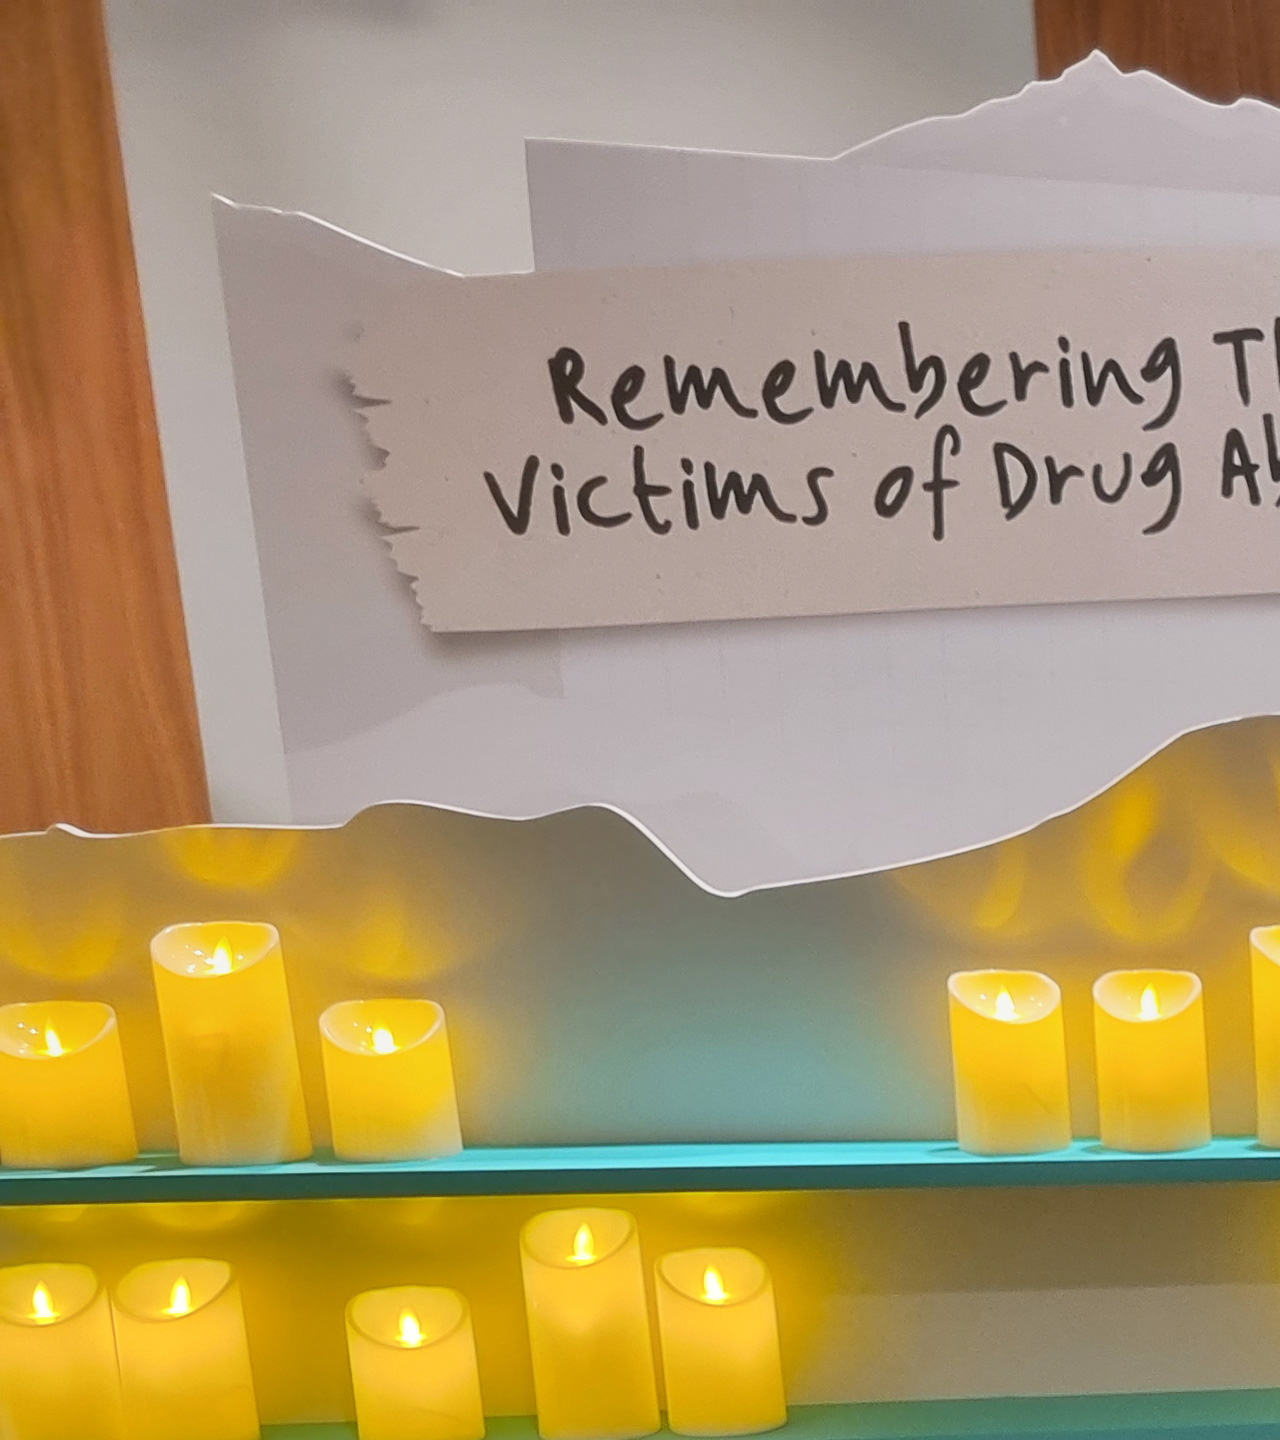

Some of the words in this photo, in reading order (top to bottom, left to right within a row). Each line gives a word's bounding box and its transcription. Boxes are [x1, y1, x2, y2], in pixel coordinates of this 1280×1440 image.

[547, 320, 1182, 431] Remembering
[484, 442, 834, 537] Victims
[874, 423, 961, 541] of
[993, 441, 1181, 535] Drug
